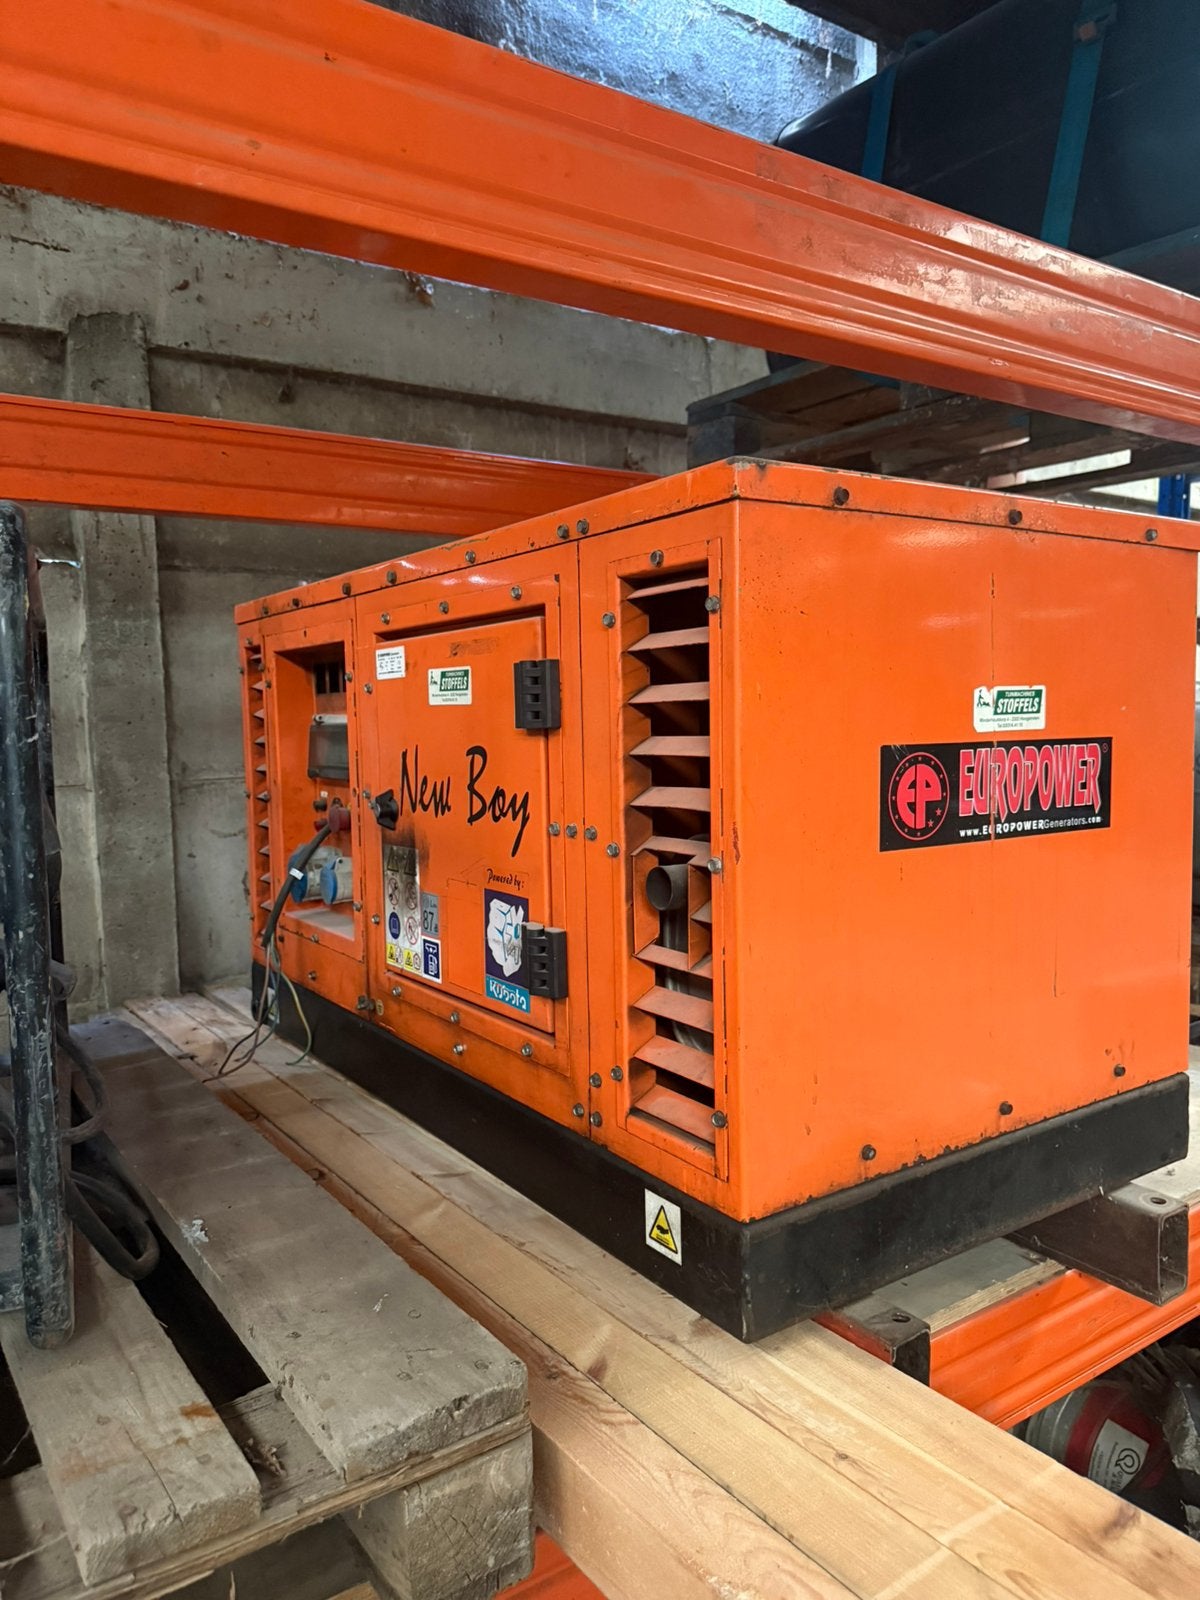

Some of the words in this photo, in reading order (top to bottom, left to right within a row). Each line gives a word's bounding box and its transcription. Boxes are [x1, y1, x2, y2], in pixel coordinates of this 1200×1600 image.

[441, 677, 468, 690] STOFFELS
[997, 697, 1040, 714] STOFFELS
[959, 743, 1102, 823] EUROPOWER
[399, 743, 453, 818] New
[465, 745, 531, 858] Boy
[487, 868, 512, 885] Powered
[513, 875, 525, 891] by:
[422, 910, 435, 932] 87
[489, 979, 527, 1010] Kubota
